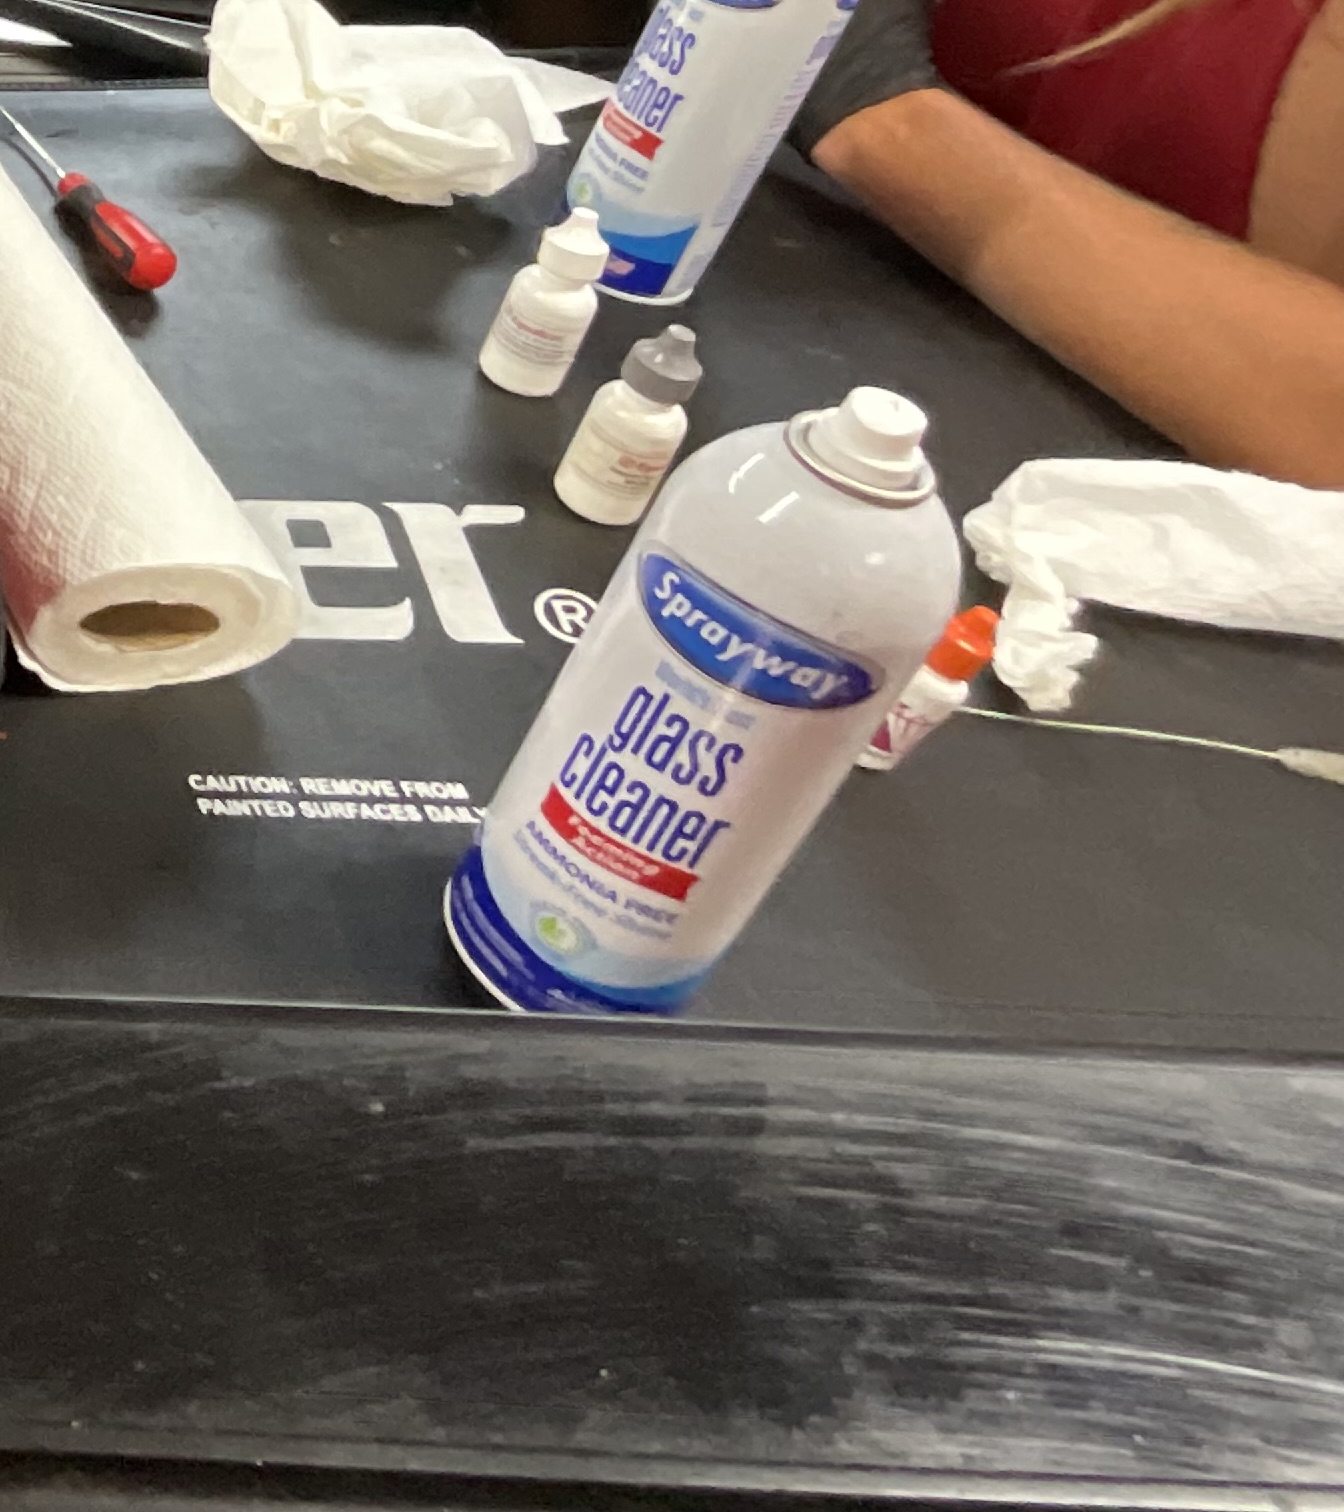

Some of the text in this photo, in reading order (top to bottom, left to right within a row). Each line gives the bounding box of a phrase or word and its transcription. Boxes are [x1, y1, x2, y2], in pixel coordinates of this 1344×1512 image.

[653, 570, 849, 701] Sprayway
[187, 774, 470, 801] CAUTION: REMOVE FROM
[607, 685, 744, 798] glass
[196, 797, 296, 819] PAINTED
[298, 800, 424, 823] SURFACES
[559, 732, 733, 869] cleaner
[525, 819, 618, 904] AMMONIA
